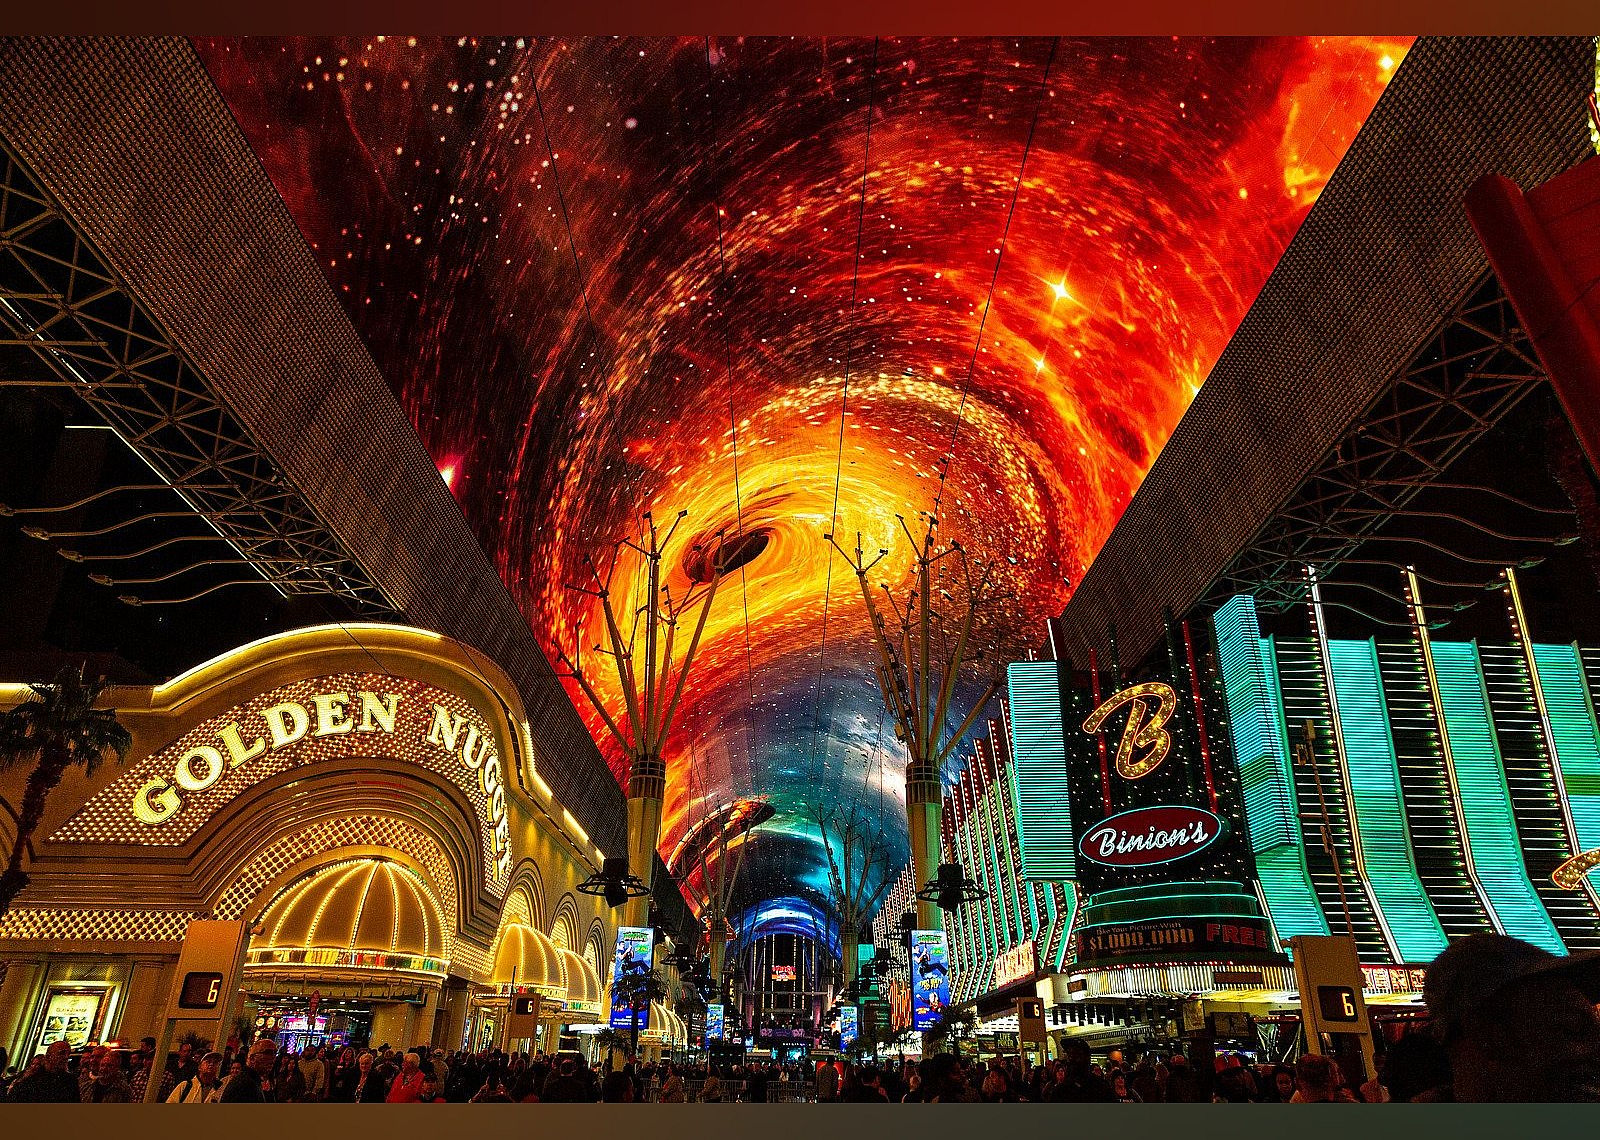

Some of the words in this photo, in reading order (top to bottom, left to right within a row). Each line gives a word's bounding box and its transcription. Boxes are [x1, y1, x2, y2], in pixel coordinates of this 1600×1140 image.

[1083, 682, 1176, 779] B
[133, 691, 403, 825] GOLDEN
[425, 702, 512, 882] NUGGET
[1090, 821, 1209, 857] Binion's
[1111, 925, 1127, 933] Your
[1206, 923, 1269, 949] FREE
[207, 979, 221, 1003] 6
[527, 1000, 533, 1013] 6
[1033, 1004, 1040, 1017] 6
[1341, 992, 1355, 1017] 6
